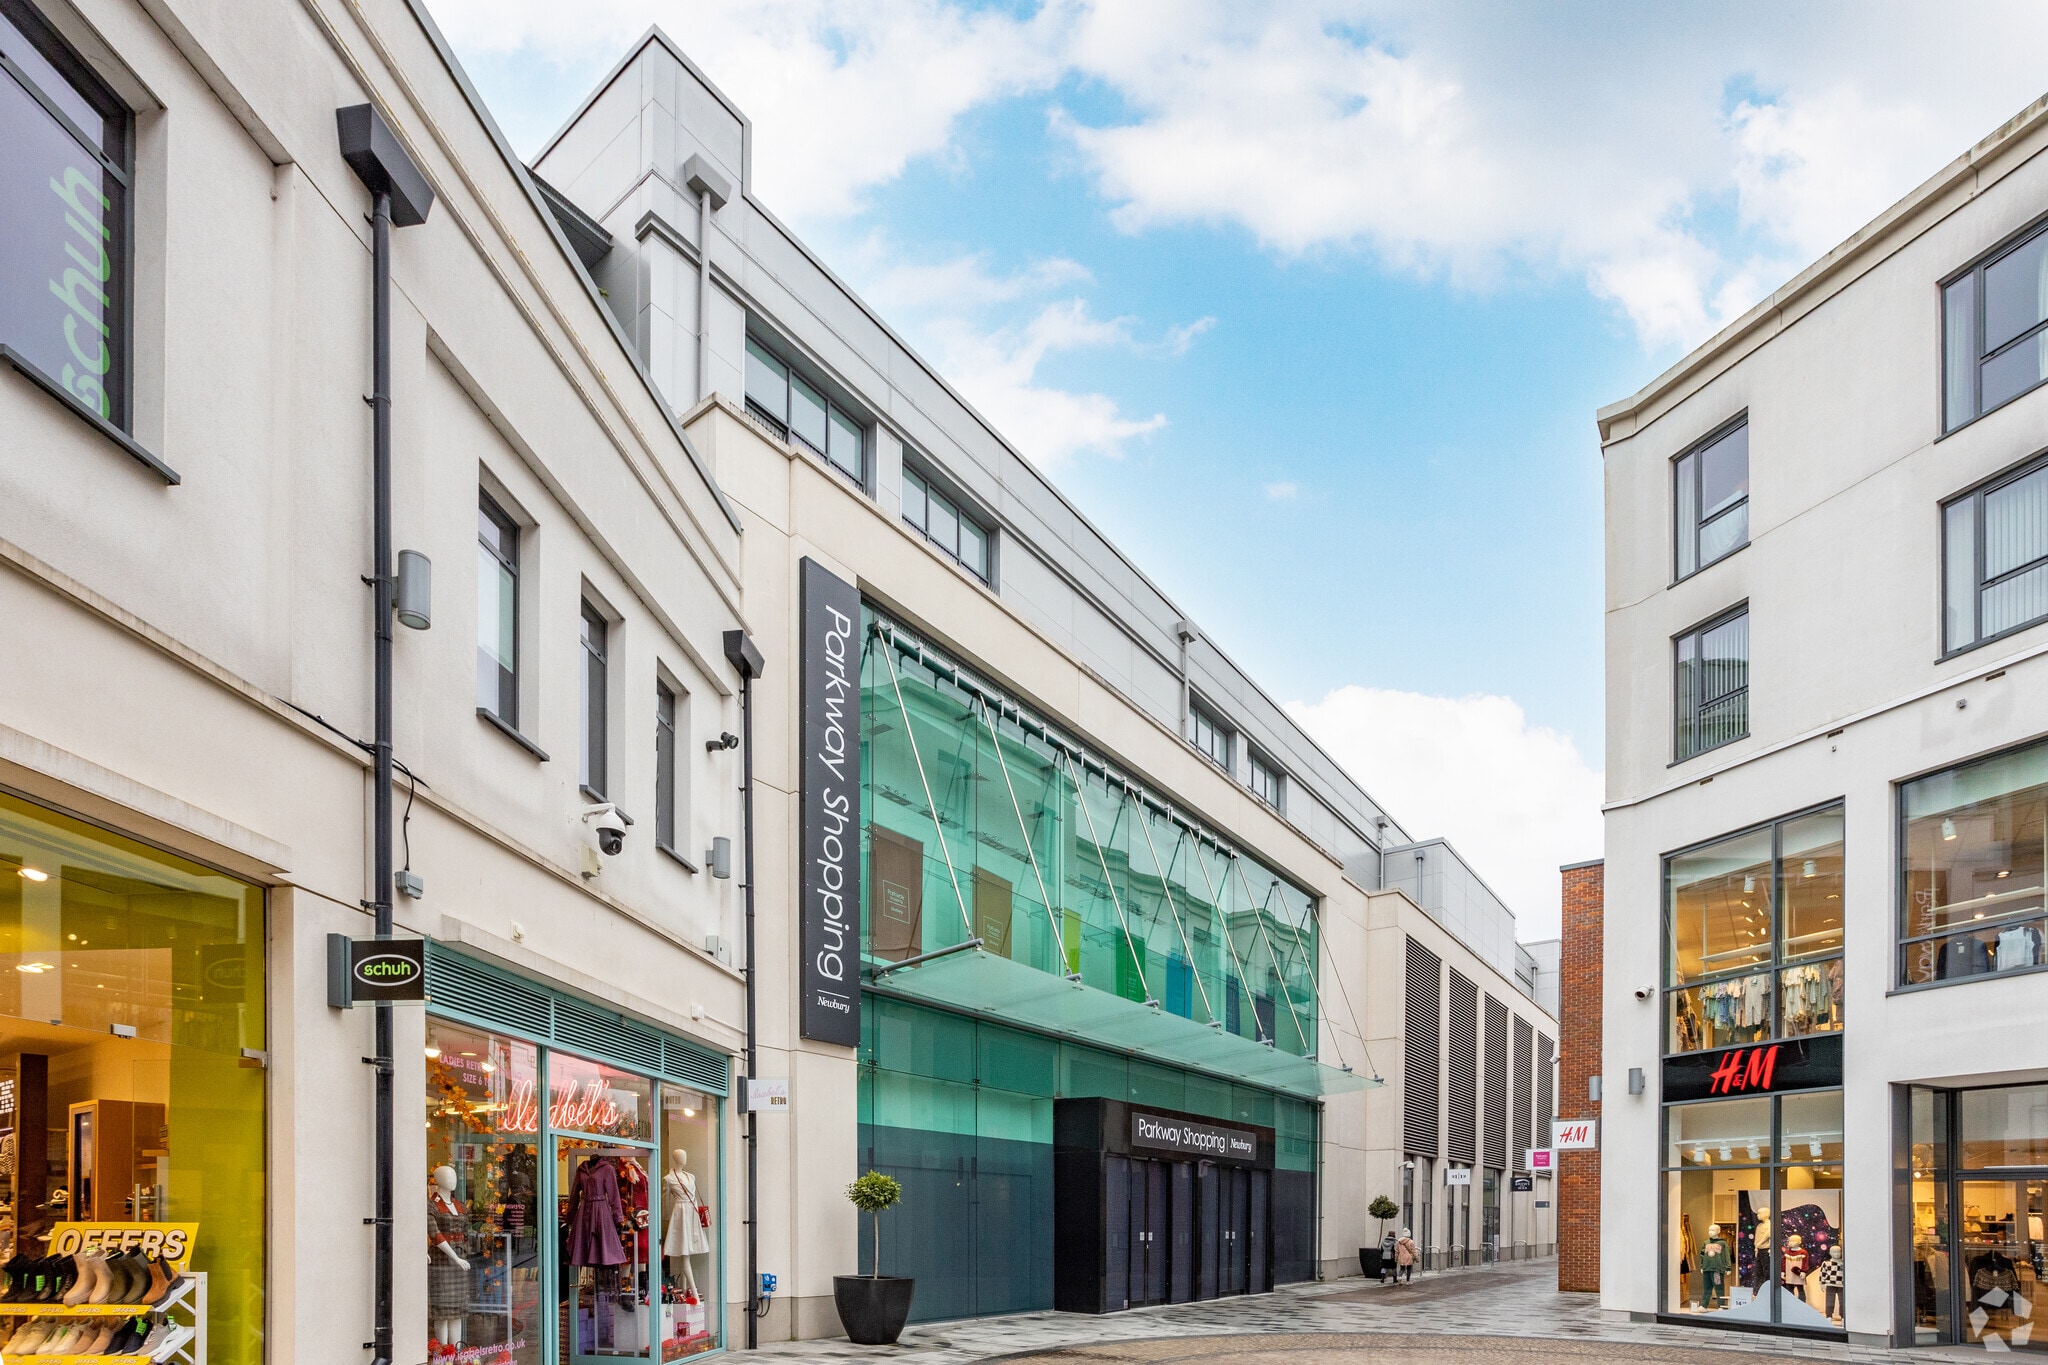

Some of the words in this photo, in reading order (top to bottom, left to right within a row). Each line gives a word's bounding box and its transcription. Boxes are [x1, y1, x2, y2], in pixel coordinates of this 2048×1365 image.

[49, 166, 111, 420] schuh
[818, 604, 851, 782] Parkway
[816, 787, 850, 982] Shopping
[363, 961, 411, 976] schuh
[816, 996, 850, 1014] Newbury
[439, 1054, 464, 1068] LADIES
[1709, 1045, 1779, 1094] H&M
[462, 1073, 477, 1084] SIZE
[770, 1096, 787, 1105] RETRO
[1138, 1118, 1182, 1146] Parkway
[1183, 1127, 1226, 1153] Shopping
[1229, 1137, 1252, 1153] Newbury
[1559, 1126, 1588, 1143] H&M
[56, 1228, 188, 1260] OFFERS
